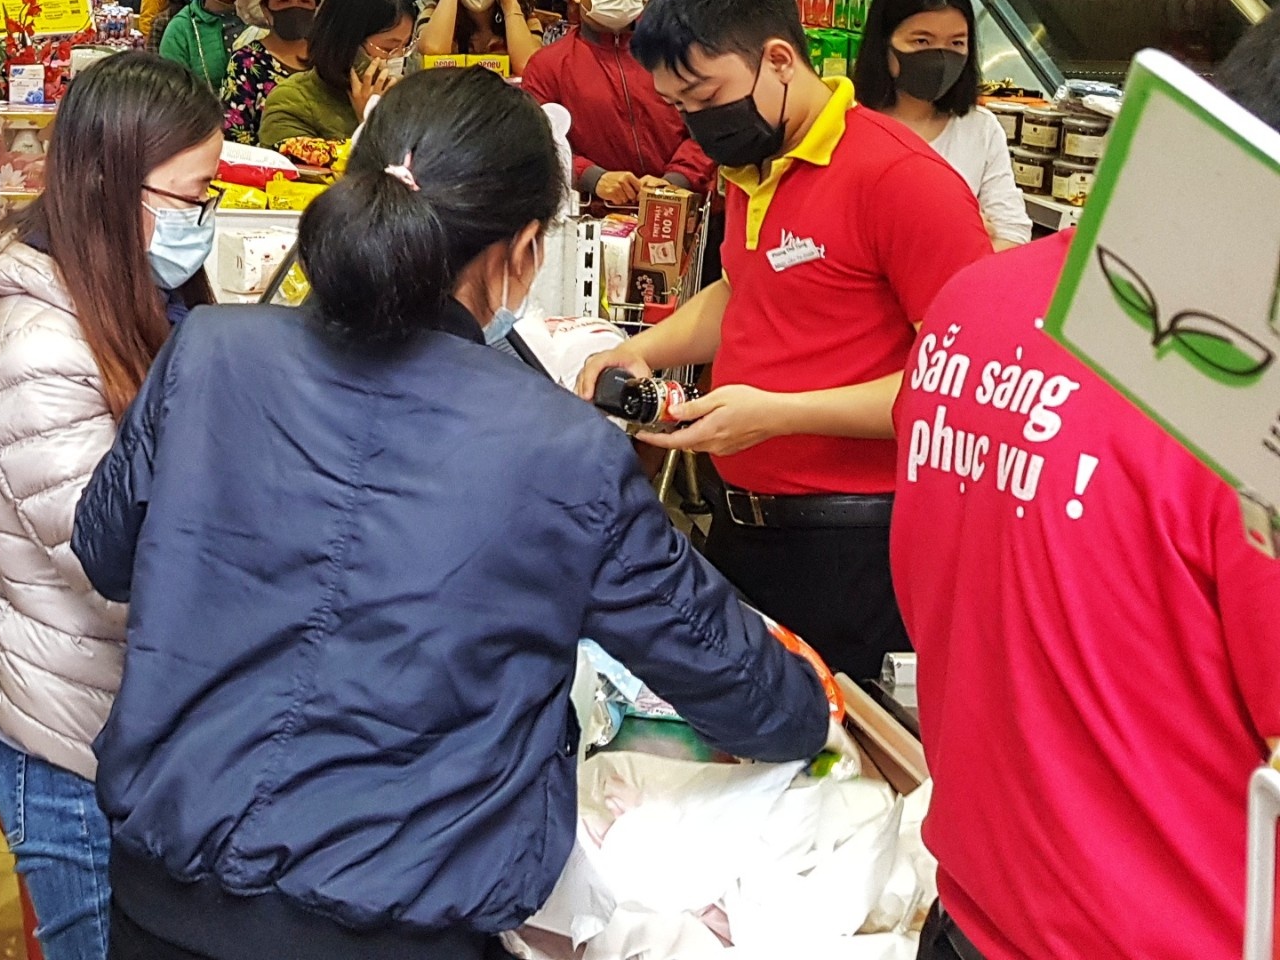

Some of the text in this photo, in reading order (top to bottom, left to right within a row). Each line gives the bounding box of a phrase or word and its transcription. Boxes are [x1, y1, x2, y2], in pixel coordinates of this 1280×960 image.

[911, 324, 970, 398] Sẵn
[908, 405, 990, 494] phục
[996, 442, 1044, 518] vụ
